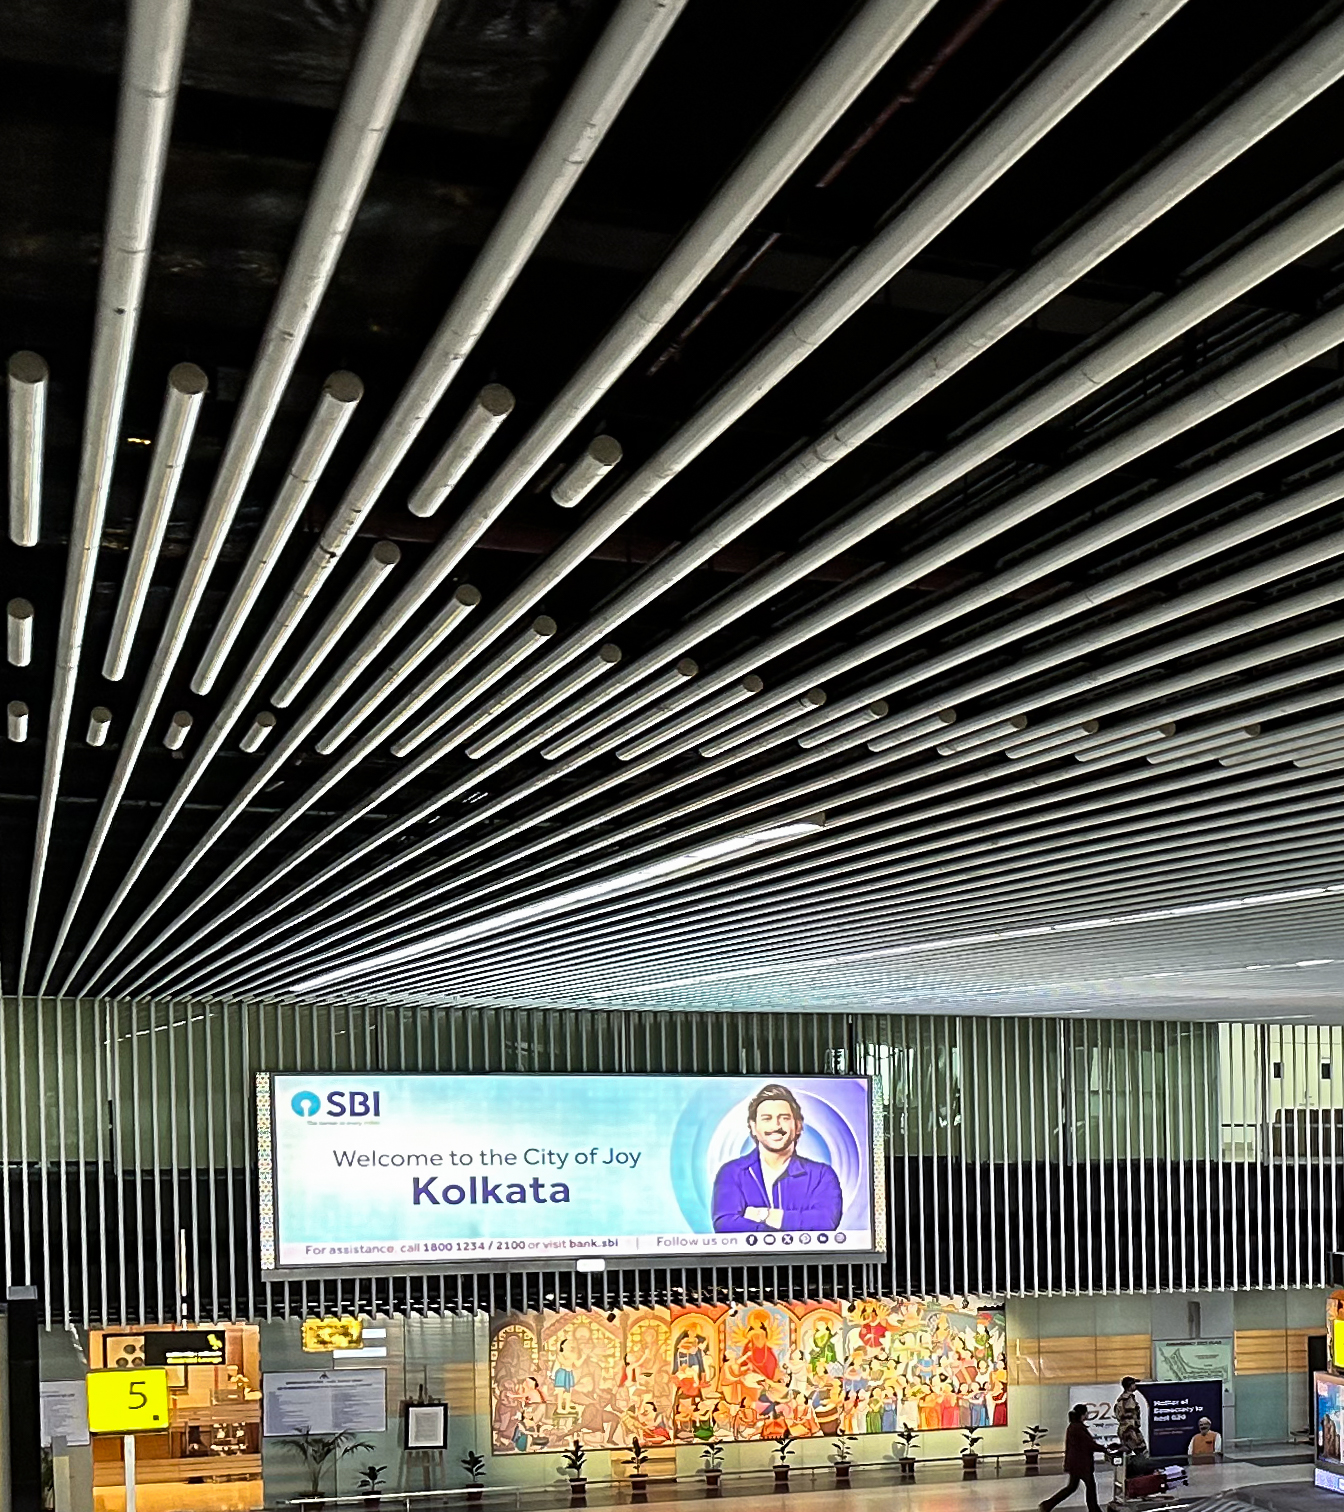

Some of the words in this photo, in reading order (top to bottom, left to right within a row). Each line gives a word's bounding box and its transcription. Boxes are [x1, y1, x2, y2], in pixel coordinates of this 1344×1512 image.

[326, 1091, 381, 1117] SBI
[333, 1149, 443, 1167] Welcome
[449, 1150, 473, 1166] to
[479, 1148, 517, 1166] the
[523, 1147, 570, 1170] City
[574, 1147, 599, 1165] of
[602, 1147, 642, 1169] Joy
[411, 1175, 571, 1206] Kolkata
[305, 1244, 326, 1255] For
[400, 1242, 420, 1253] call
[423, 1242, 453, 1252] 1800
[456, 1241, 485, 1251] 1234
[496, 1240, 526, 1250] 2100
[528, 1241, 540, 1250] or
[543, 1239, 567, 1250] visit
[656, 1236, 699, 1247] Follow
[702, 1237, 717, 1246] us
[721, 1236, 738, 1246] on
[128, 1380, 148, 1410] 5
